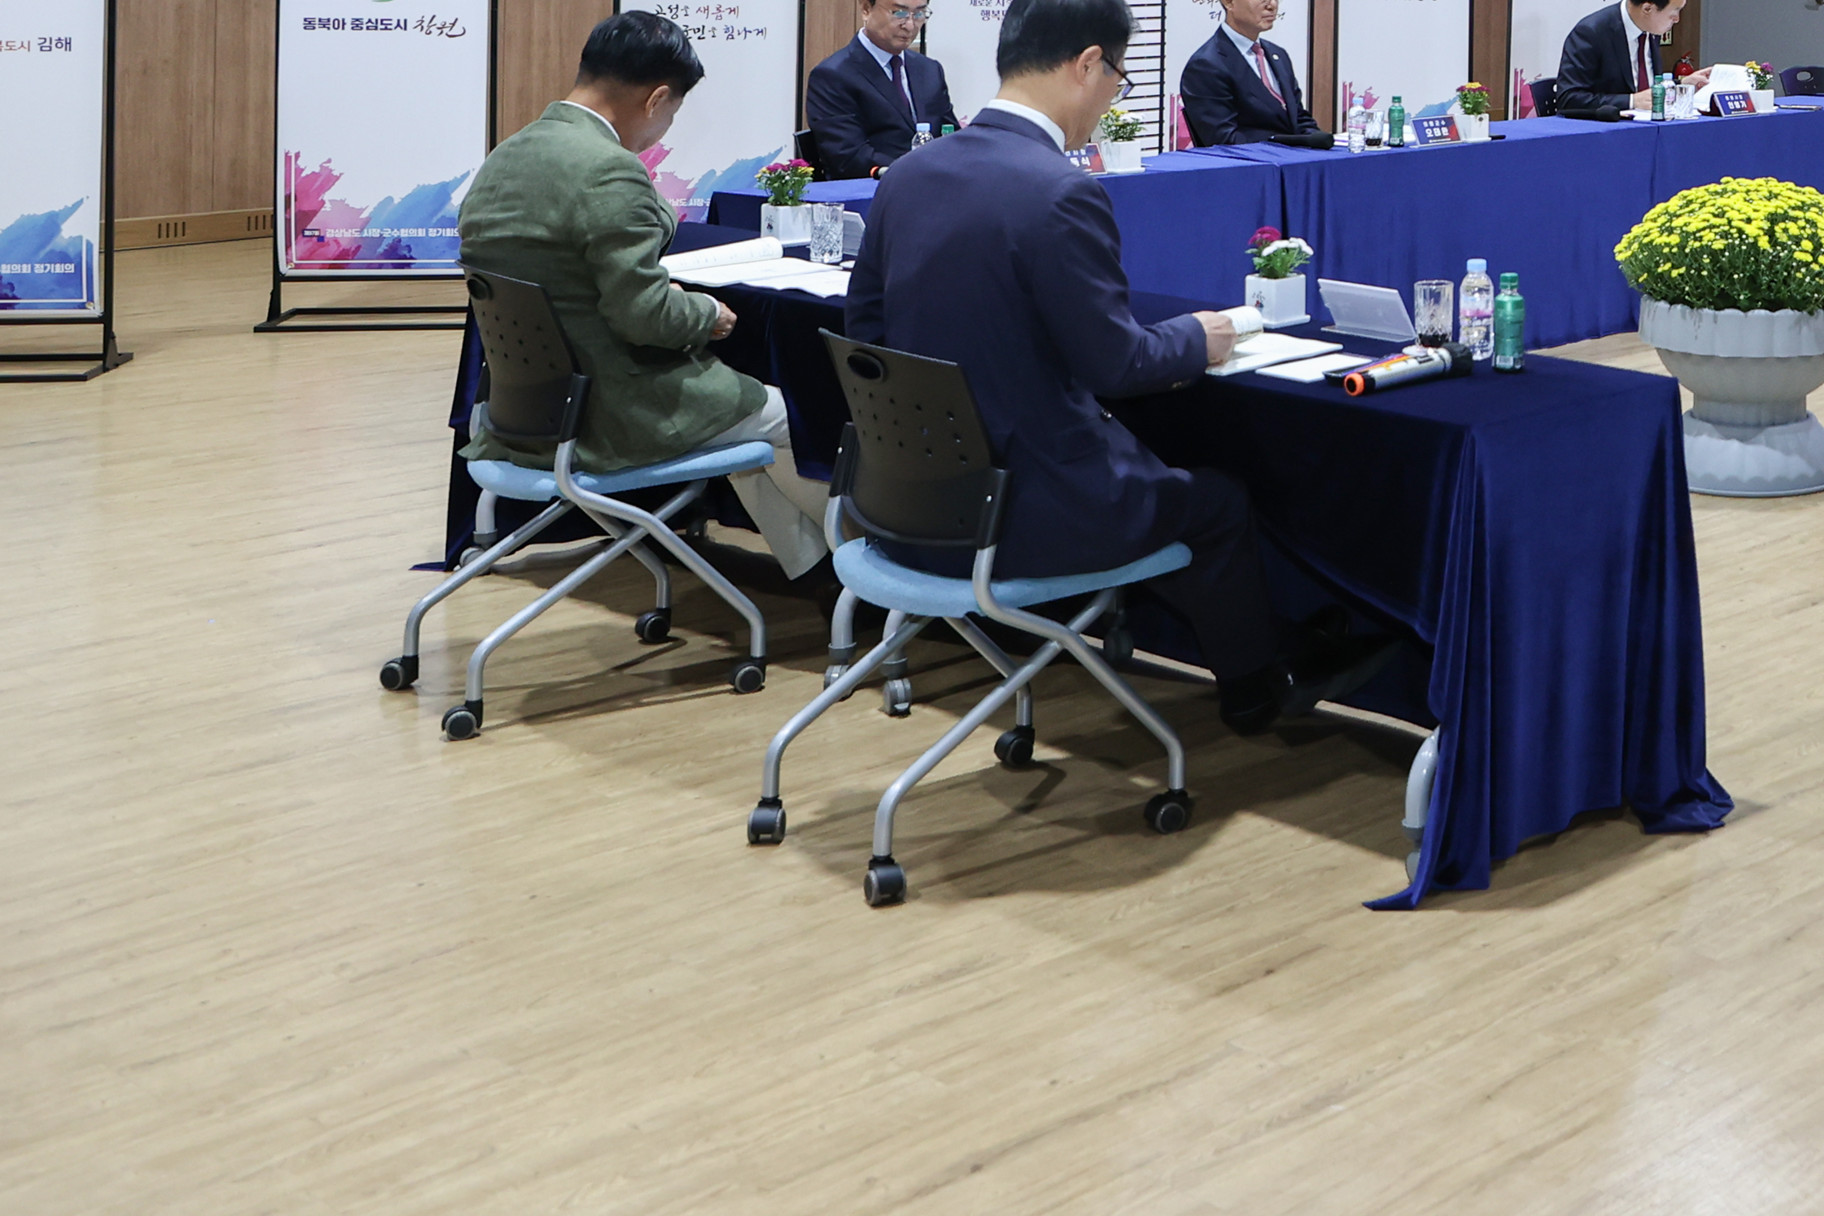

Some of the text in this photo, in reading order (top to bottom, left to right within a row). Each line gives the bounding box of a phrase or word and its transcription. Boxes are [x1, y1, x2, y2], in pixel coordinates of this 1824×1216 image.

[695, 3, 740, 21] 새롭게
[302, 14, 467, 39] 동북아 중심도시 창원
[723, 24, 768, 41] 힘나게
[0, 36, 72, 52] 도시 김해
